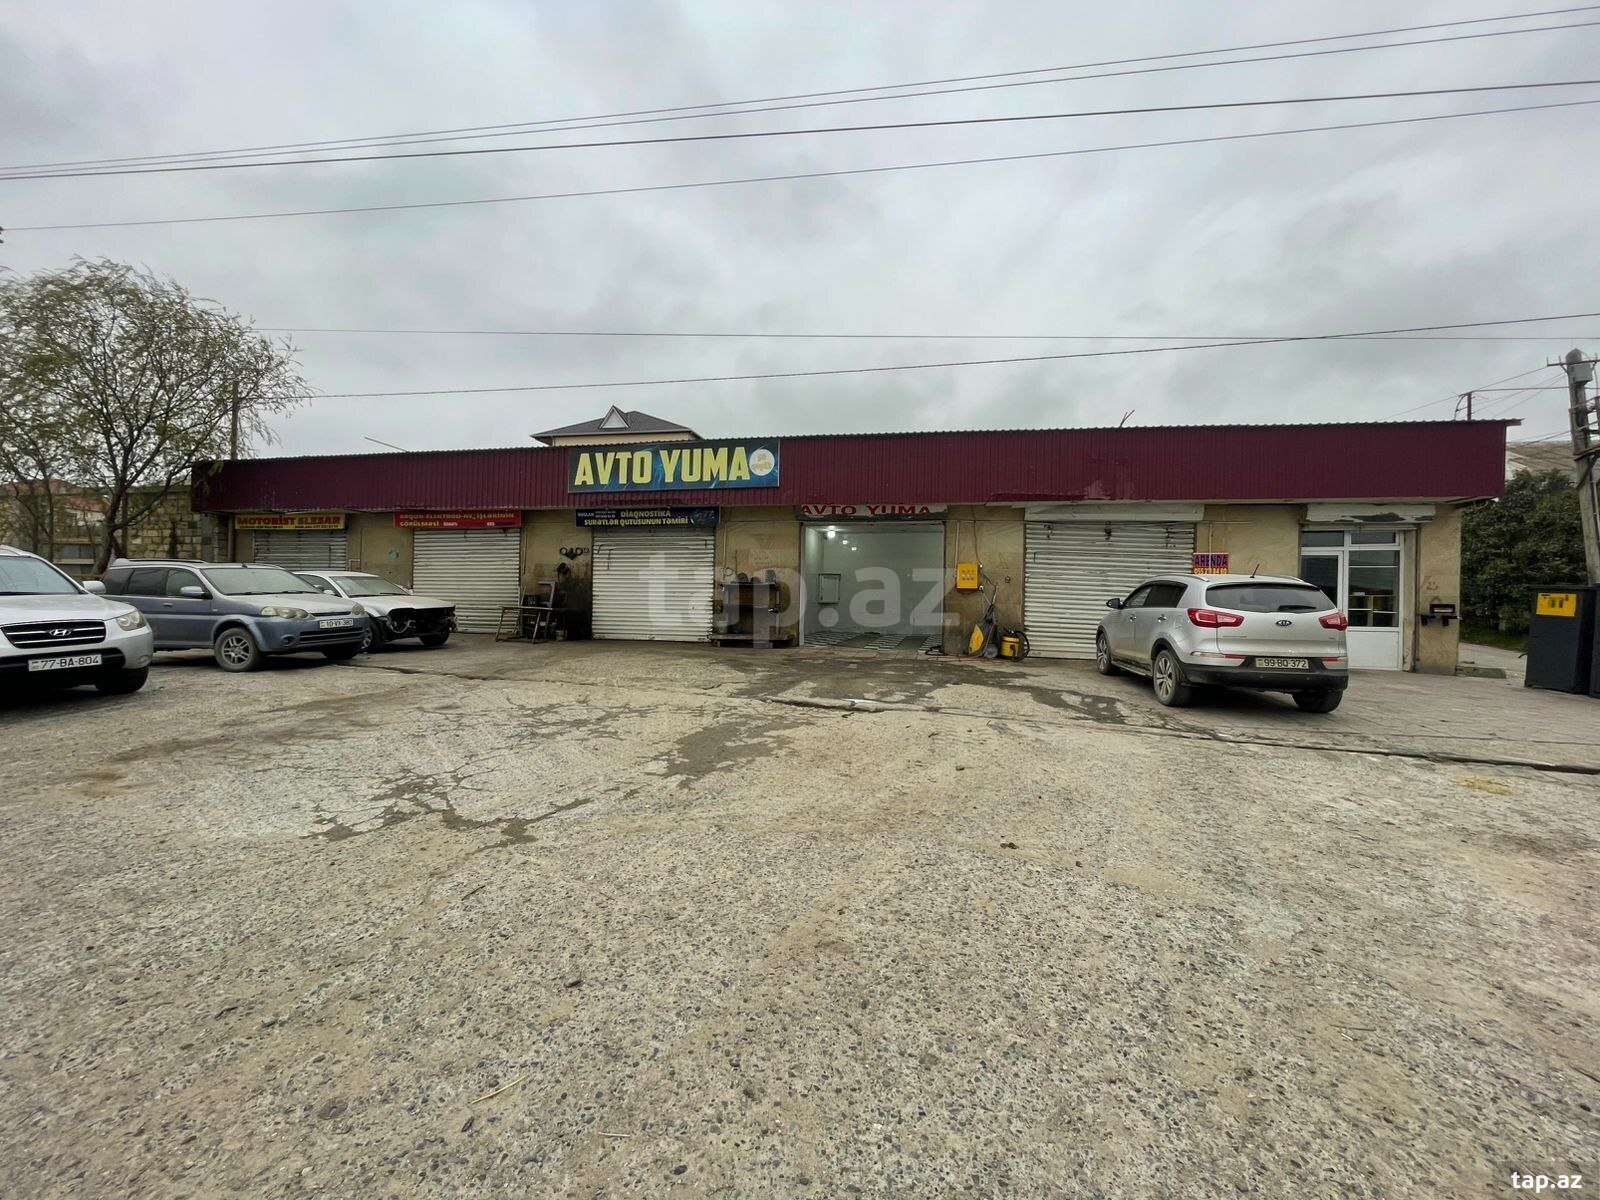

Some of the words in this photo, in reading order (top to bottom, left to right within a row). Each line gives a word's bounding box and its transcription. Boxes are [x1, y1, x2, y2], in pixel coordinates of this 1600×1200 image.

[574, 451, 652, 485] AVTO
[659, 446, 751, 483] YUMA
[802, 505, 857, 515] AVTO
[866, 505, 930, 515] YUMA
[1194, 554, 1227, 567] ARENDA
[41, 656, 99, 669] 77-BA-804
